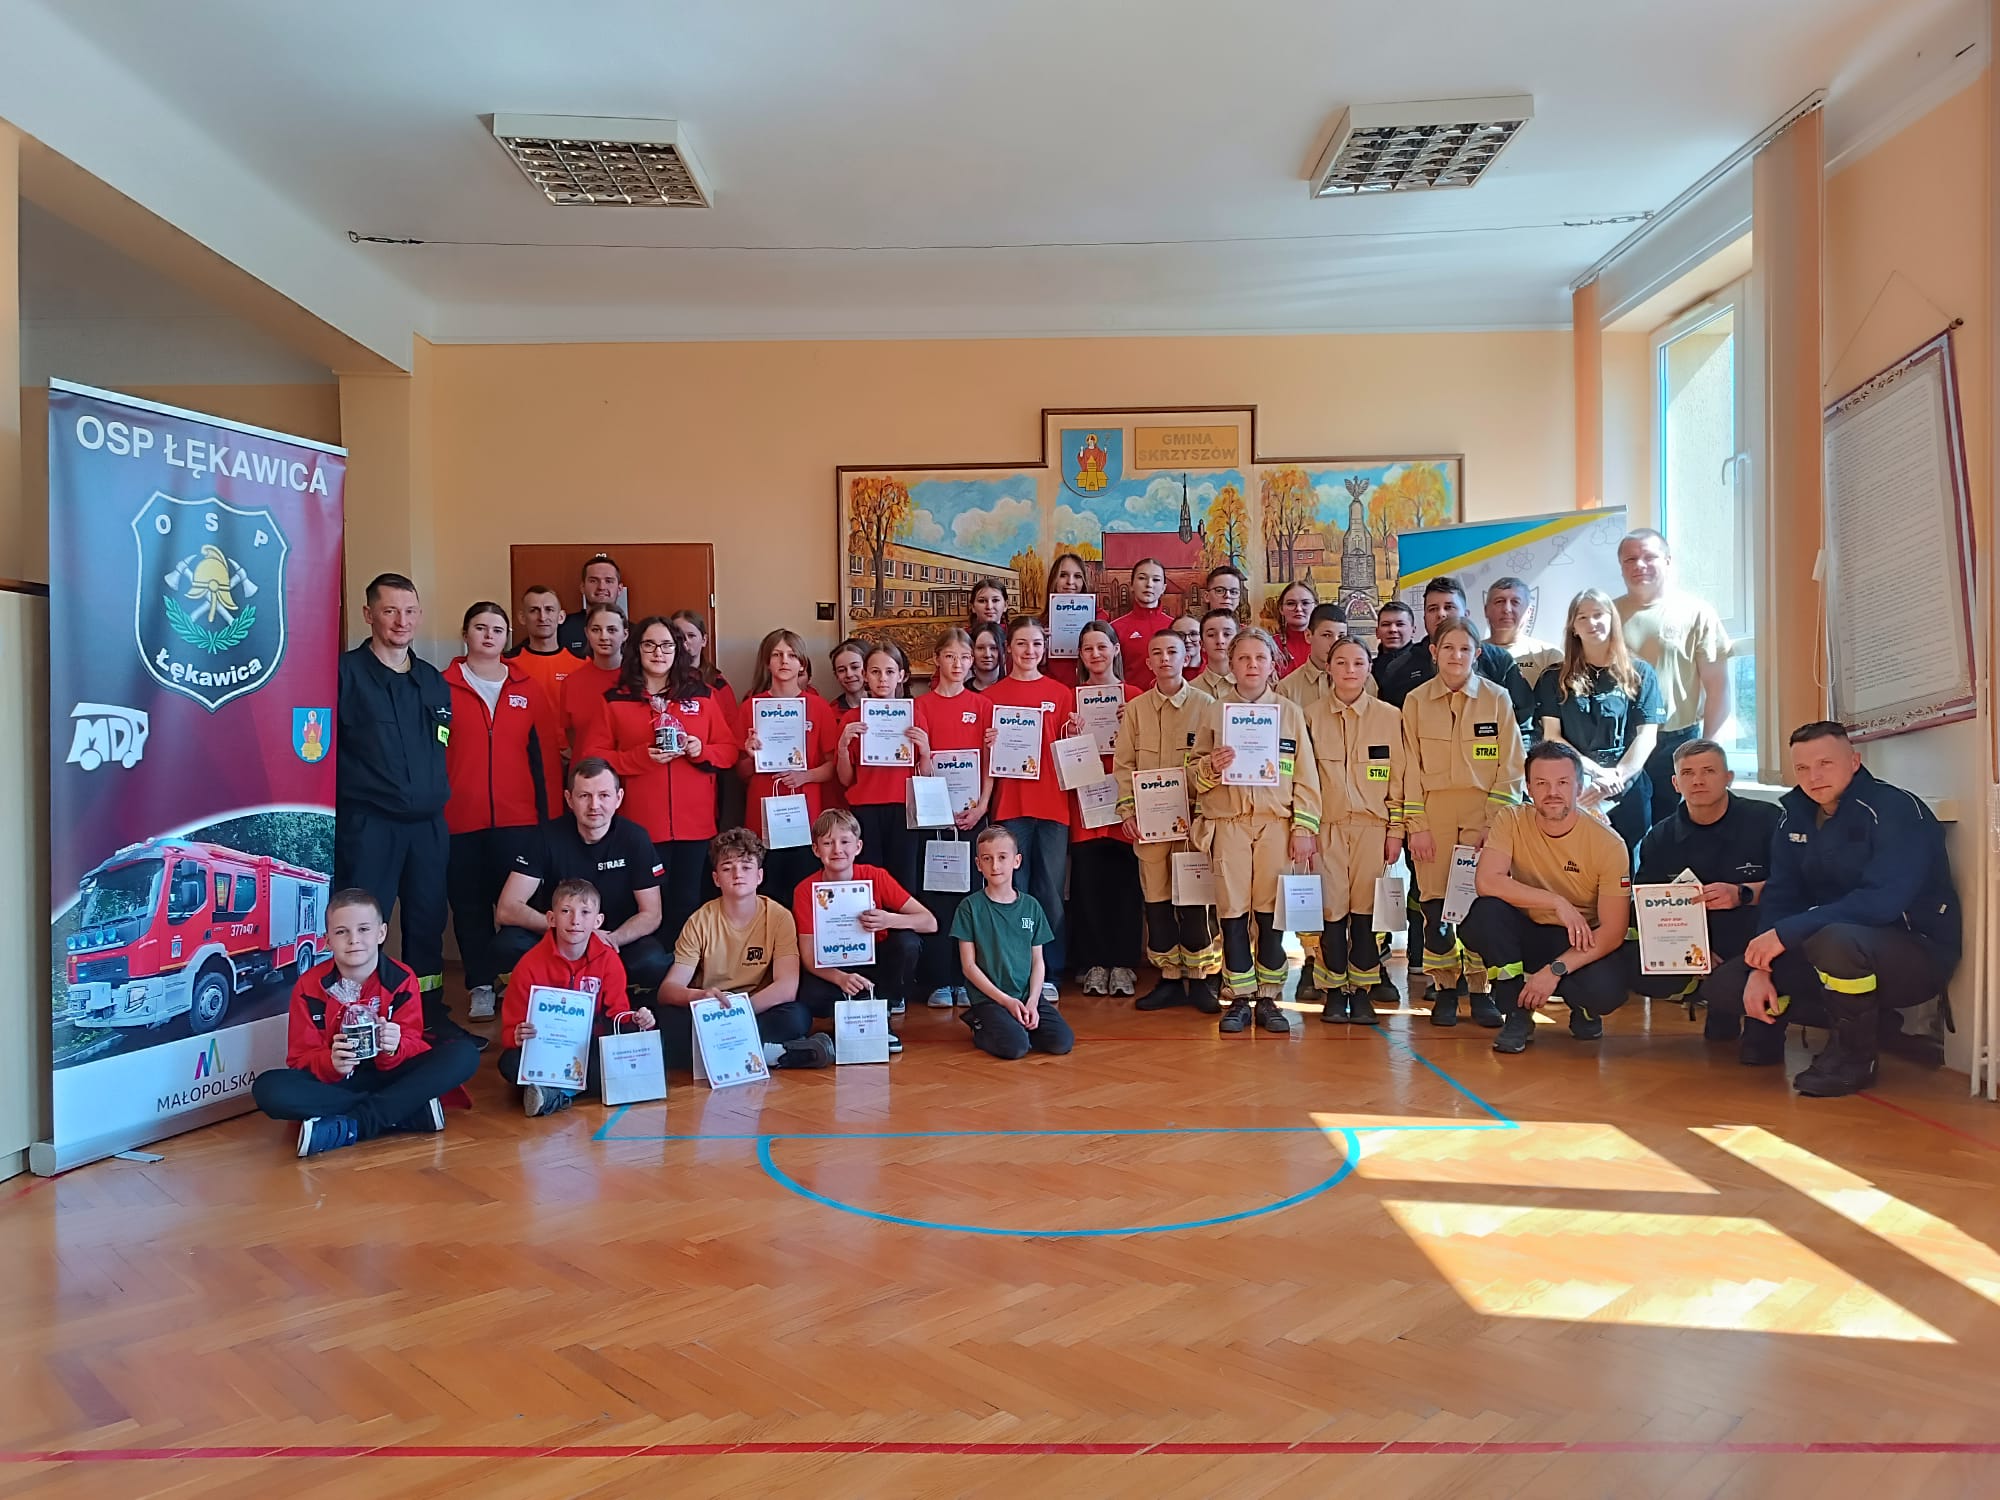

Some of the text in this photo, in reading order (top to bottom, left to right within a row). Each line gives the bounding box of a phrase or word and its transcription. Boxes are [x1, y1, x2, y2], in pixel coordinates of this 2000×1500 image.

[1161, 433, 1214, 446] GMINA
[76, 415, 328, 496] OSP ŁĘKAWICA
[1138, 446, 1236, 462] SKRZYSZÓW
[155, 647, 263, 687] Łękawica
[1083, 695, 1118, 705] DYPLOM
[760, 710, 799, 718] DYPLOM
[868, 709, 907, 717] DYPLOM
[1000, 717, 1036, 727] DYPLOM
[1232, 716, 1273, 726] DYPLOM
[65, 702, 150, 771] MDP
[937, 761, 973, 770] DYPLOM
[1141, 780, 1179, 790] DYPLOM
[1457, 858, 1479, 868] DYPL
[823, 942, 867, 953] DYPLOM
[538, 1002, 585, 1017] DYPLOM
[702, 1006, 746, 1023] DYPLOM
[157, 1070, 257, 1113] MAŁOPOLSKA
